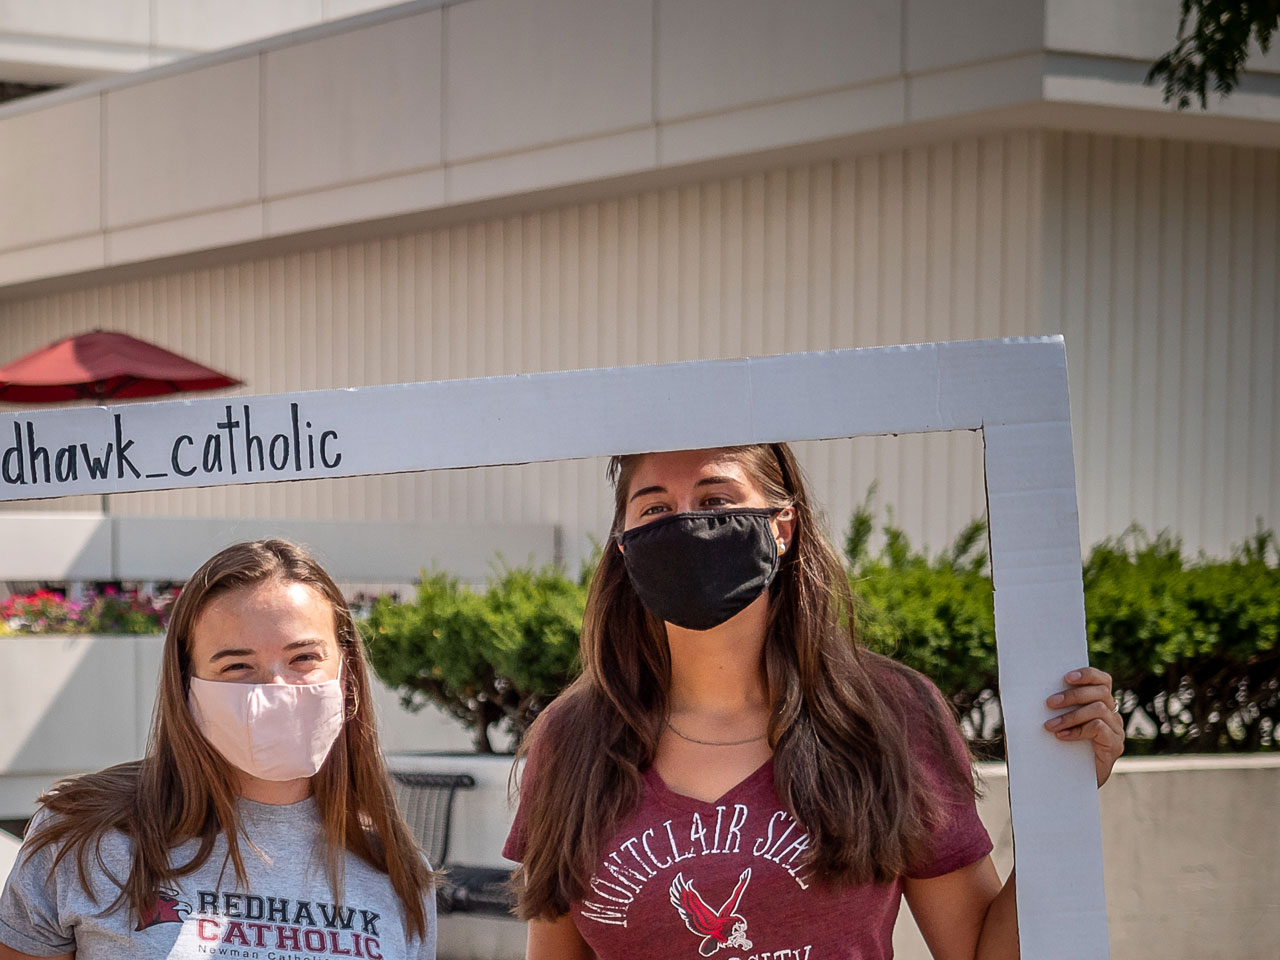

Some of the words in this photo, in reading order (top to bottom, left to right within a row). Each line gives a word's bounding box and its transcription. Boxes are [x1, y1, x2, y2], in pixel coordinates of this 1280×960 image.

[581, 804, 748, 928] MONTCLAIR
[197, 890, 381, 938] REDHAWK
[198, 944, 259, 959] Newman
